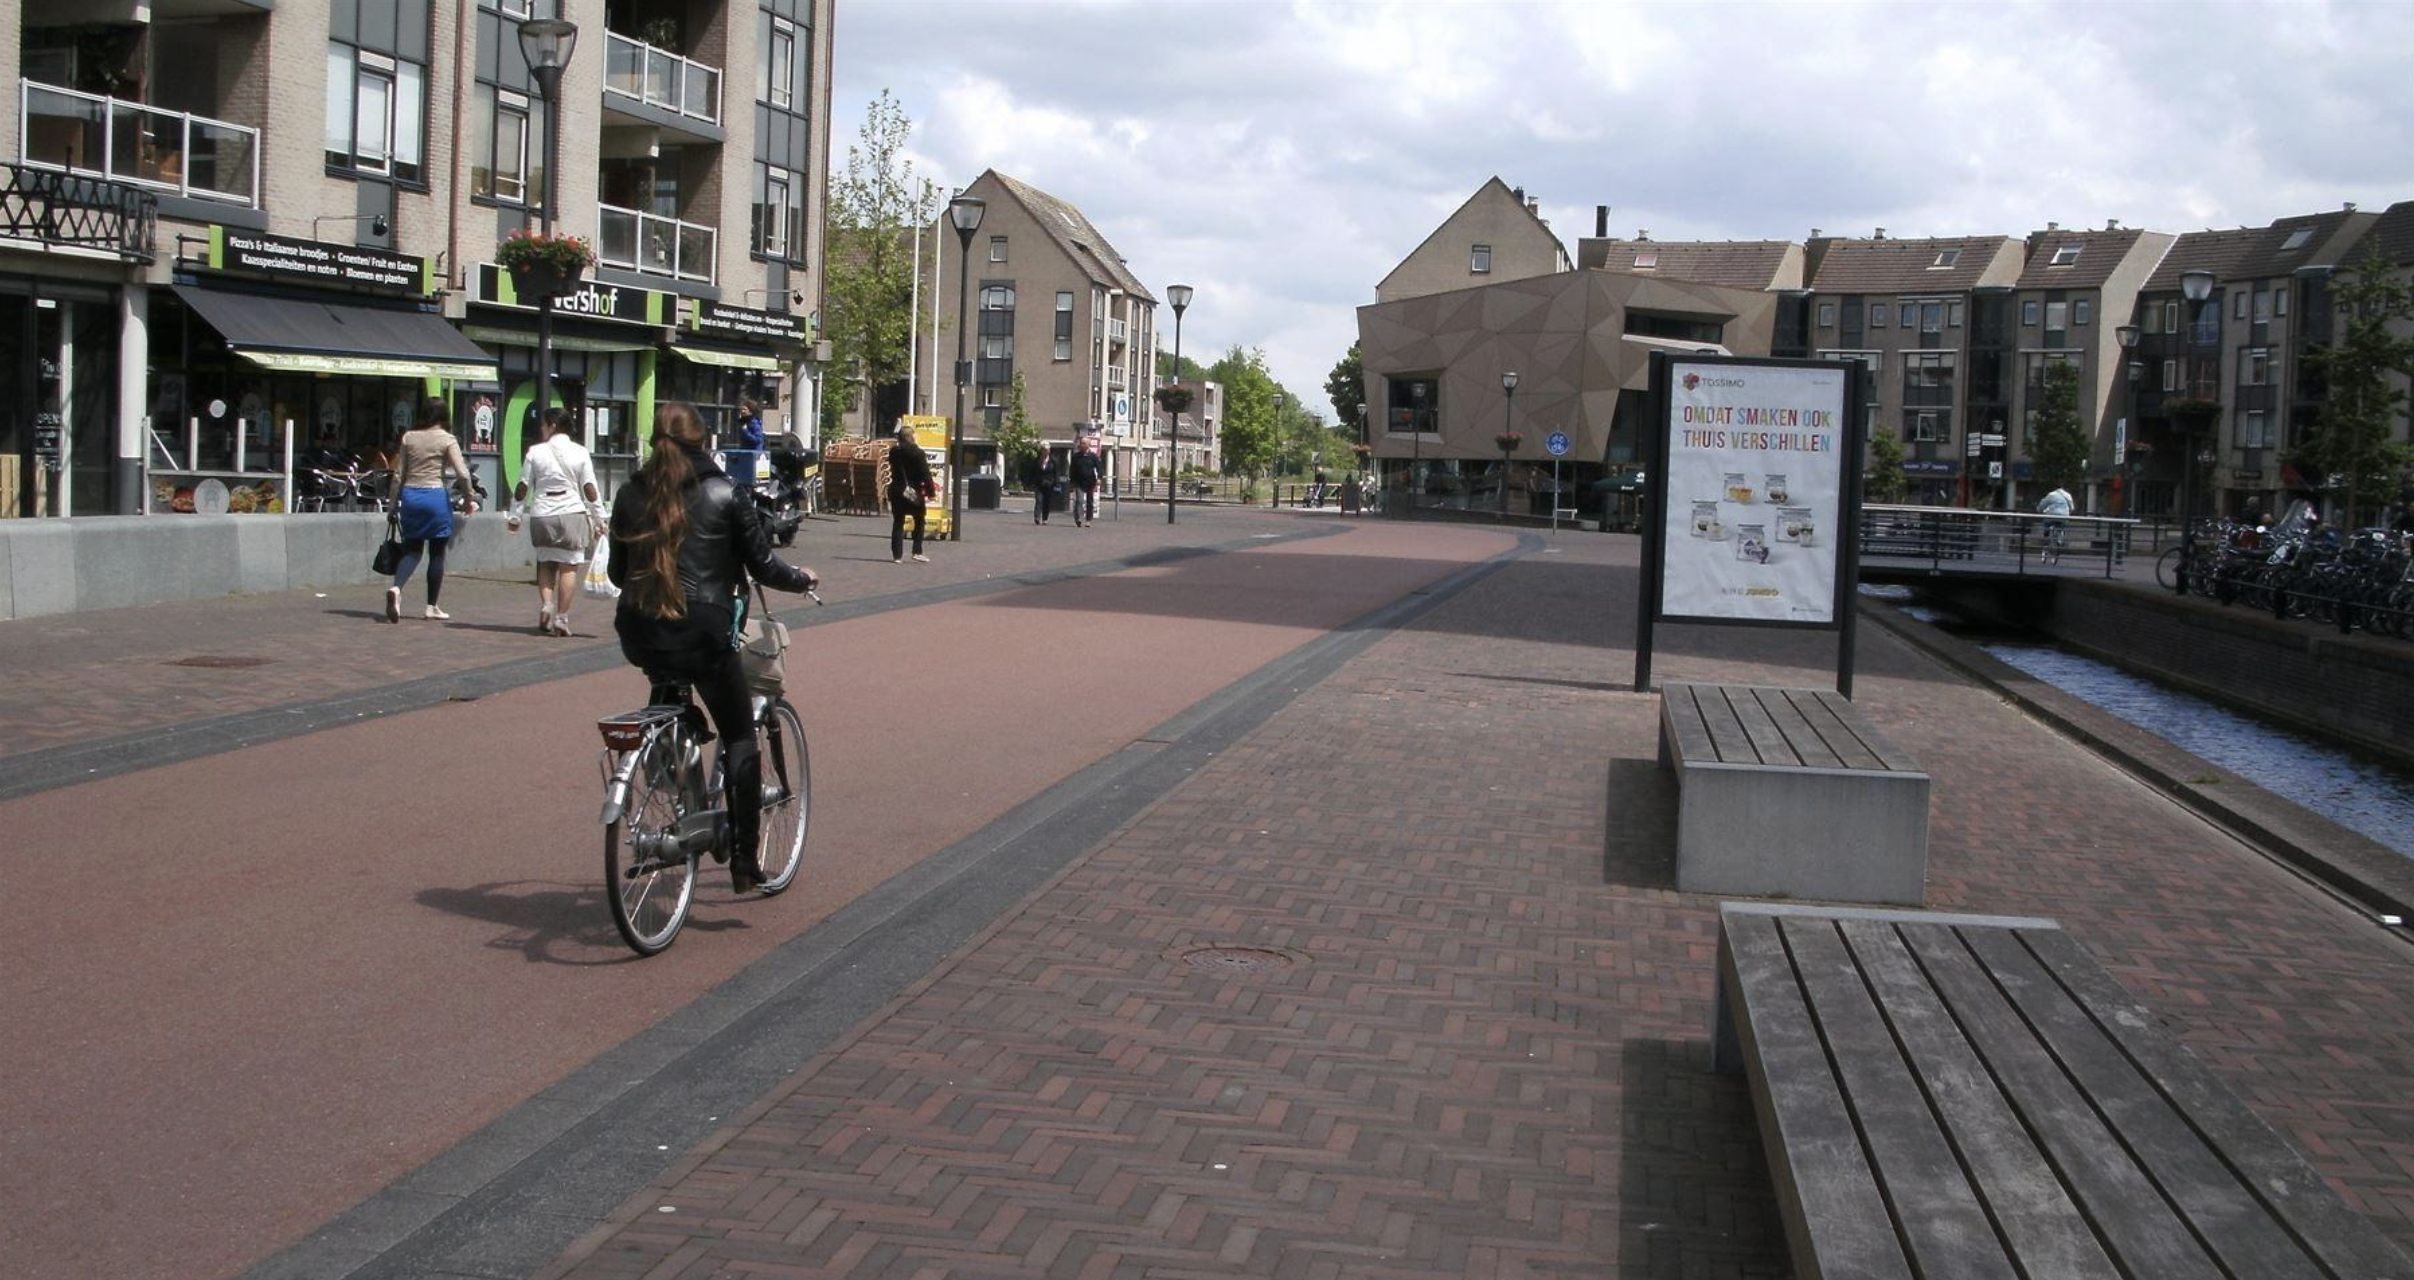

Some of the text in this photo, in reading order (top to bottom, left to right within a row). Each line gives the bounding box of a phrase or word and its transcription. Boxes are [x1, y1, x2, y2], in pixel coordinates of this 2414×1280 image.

[229, 236, 329, 261] Pizza's & Italiaanse broodjes
[241, 253, 338, 276] Kaasspecialiteiten en noten
[371, 257, 387, 269] Fruit
[387, 261, 397, 270] en
[346, 267, 409, 285] Bloemen en planten
[1701, 377, 1745, 388] TOSSIMO
[1684, 405, 1831, 428] OMDAT SMAKEN OOK
[1682, 429, 1831, 452] THUIS VERSCHILLEN
